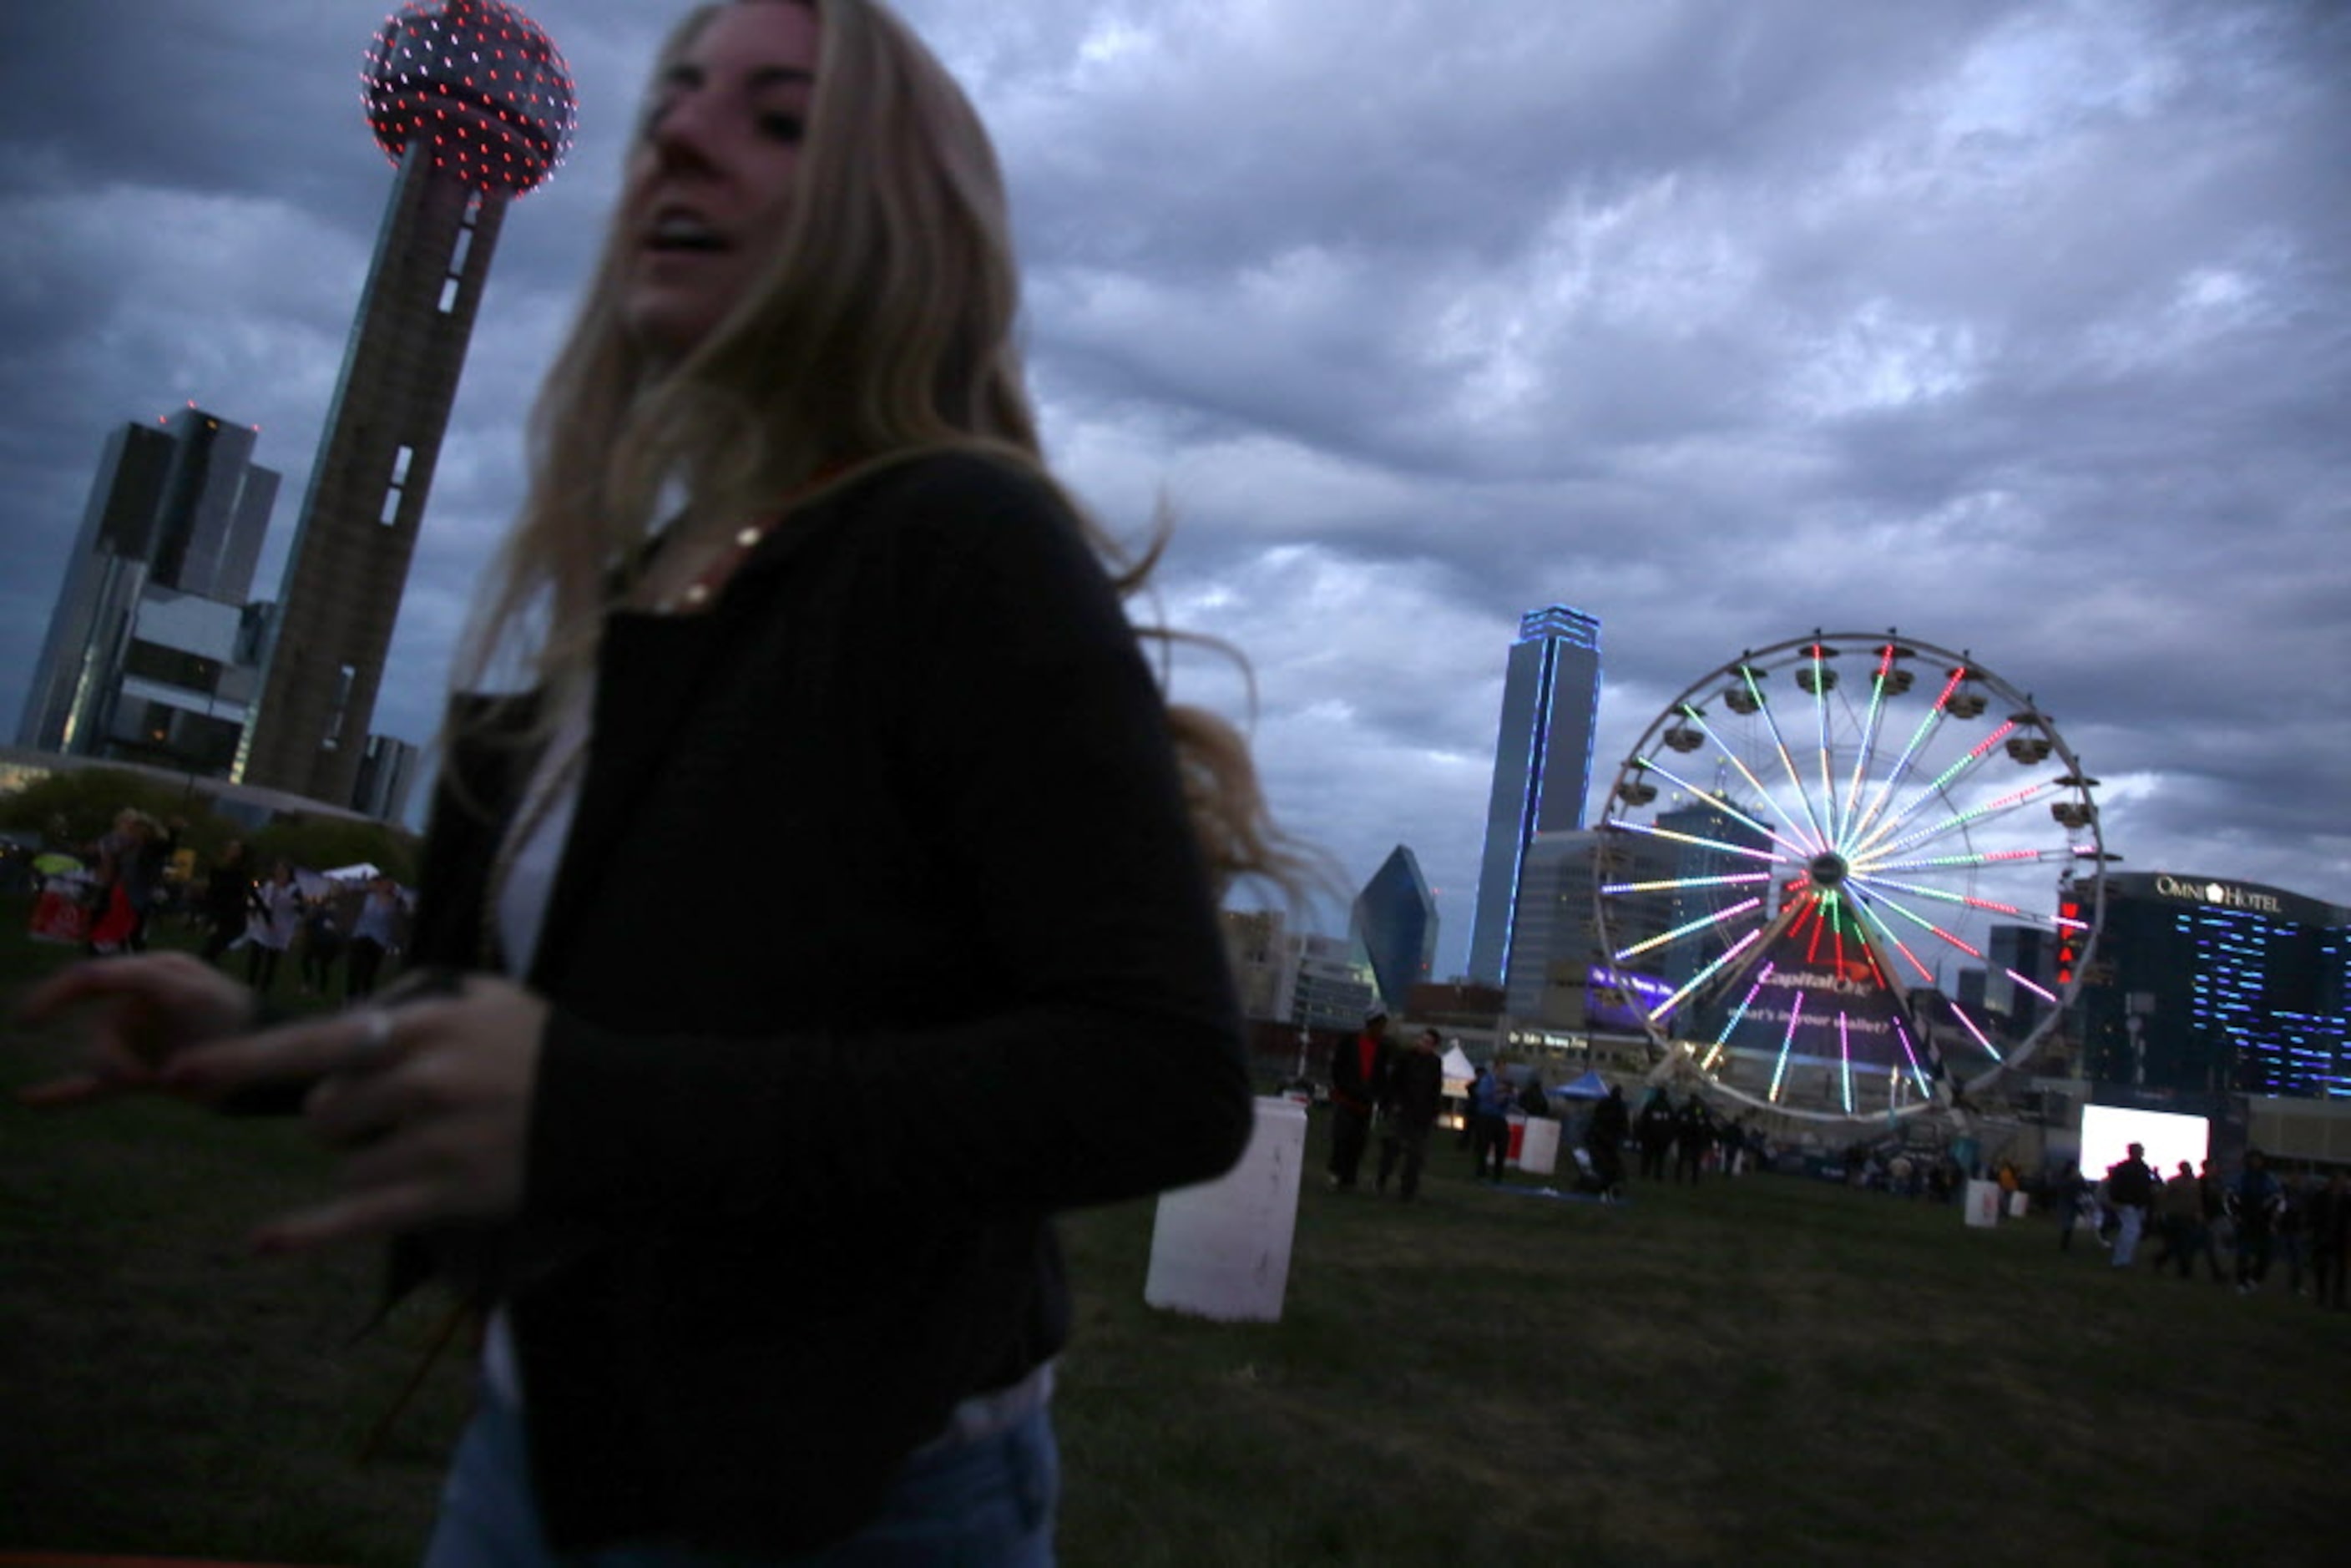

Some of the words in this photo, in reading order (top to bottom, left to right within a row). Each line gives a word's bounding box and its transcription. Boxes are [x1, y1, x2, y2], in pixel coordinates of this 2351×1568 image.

[2156, 875, 2206, 901] OMNI
[2224, 885, 2283, 913] HOTEL
[1727, 1007, 1775, 1022] wat's
